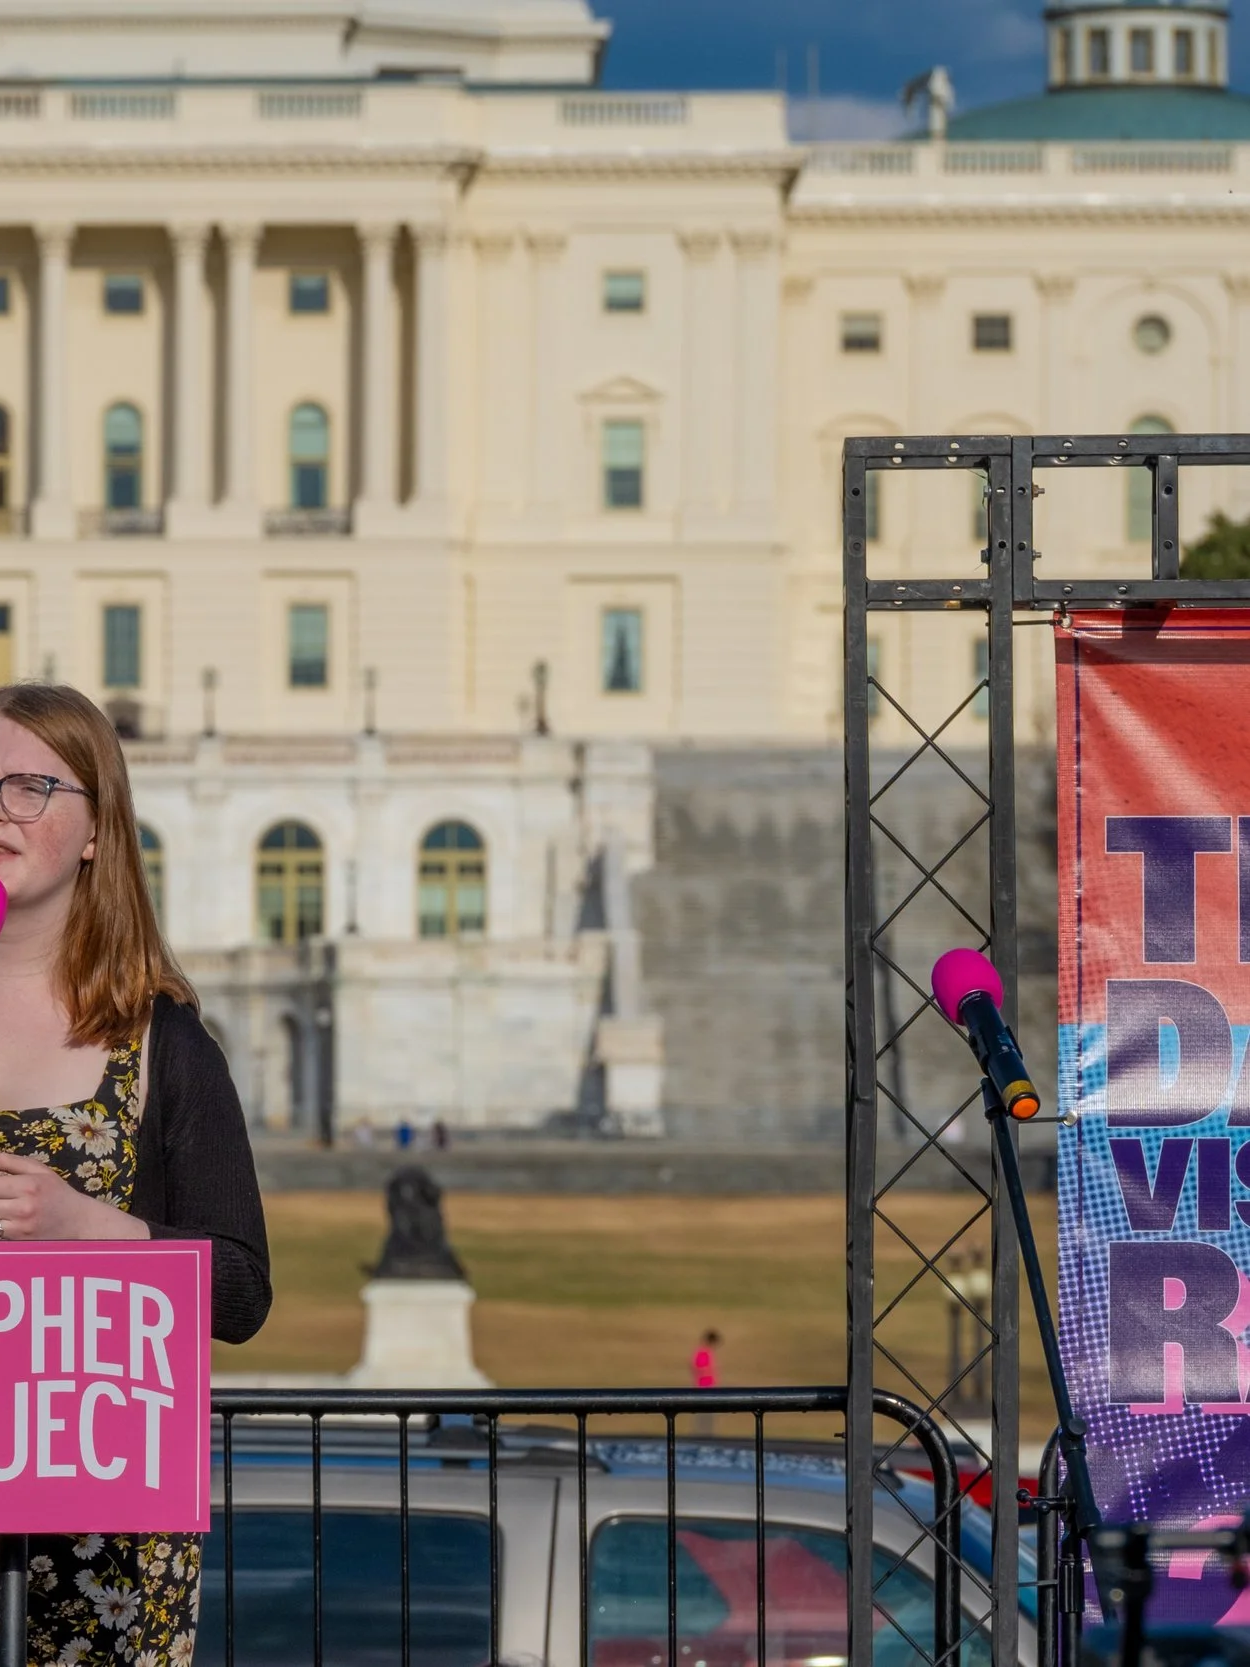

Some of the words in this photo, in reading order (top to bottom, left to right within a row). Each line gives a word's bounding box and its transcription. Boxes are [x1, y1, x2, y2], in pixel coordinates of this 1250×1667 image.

[1105, 815, 1250, 964] T
[1106, 979, 1250, 1128] D
[1108, 1137, 1250, 1231] VI
[1108, 1241, 1250, 1405] R
